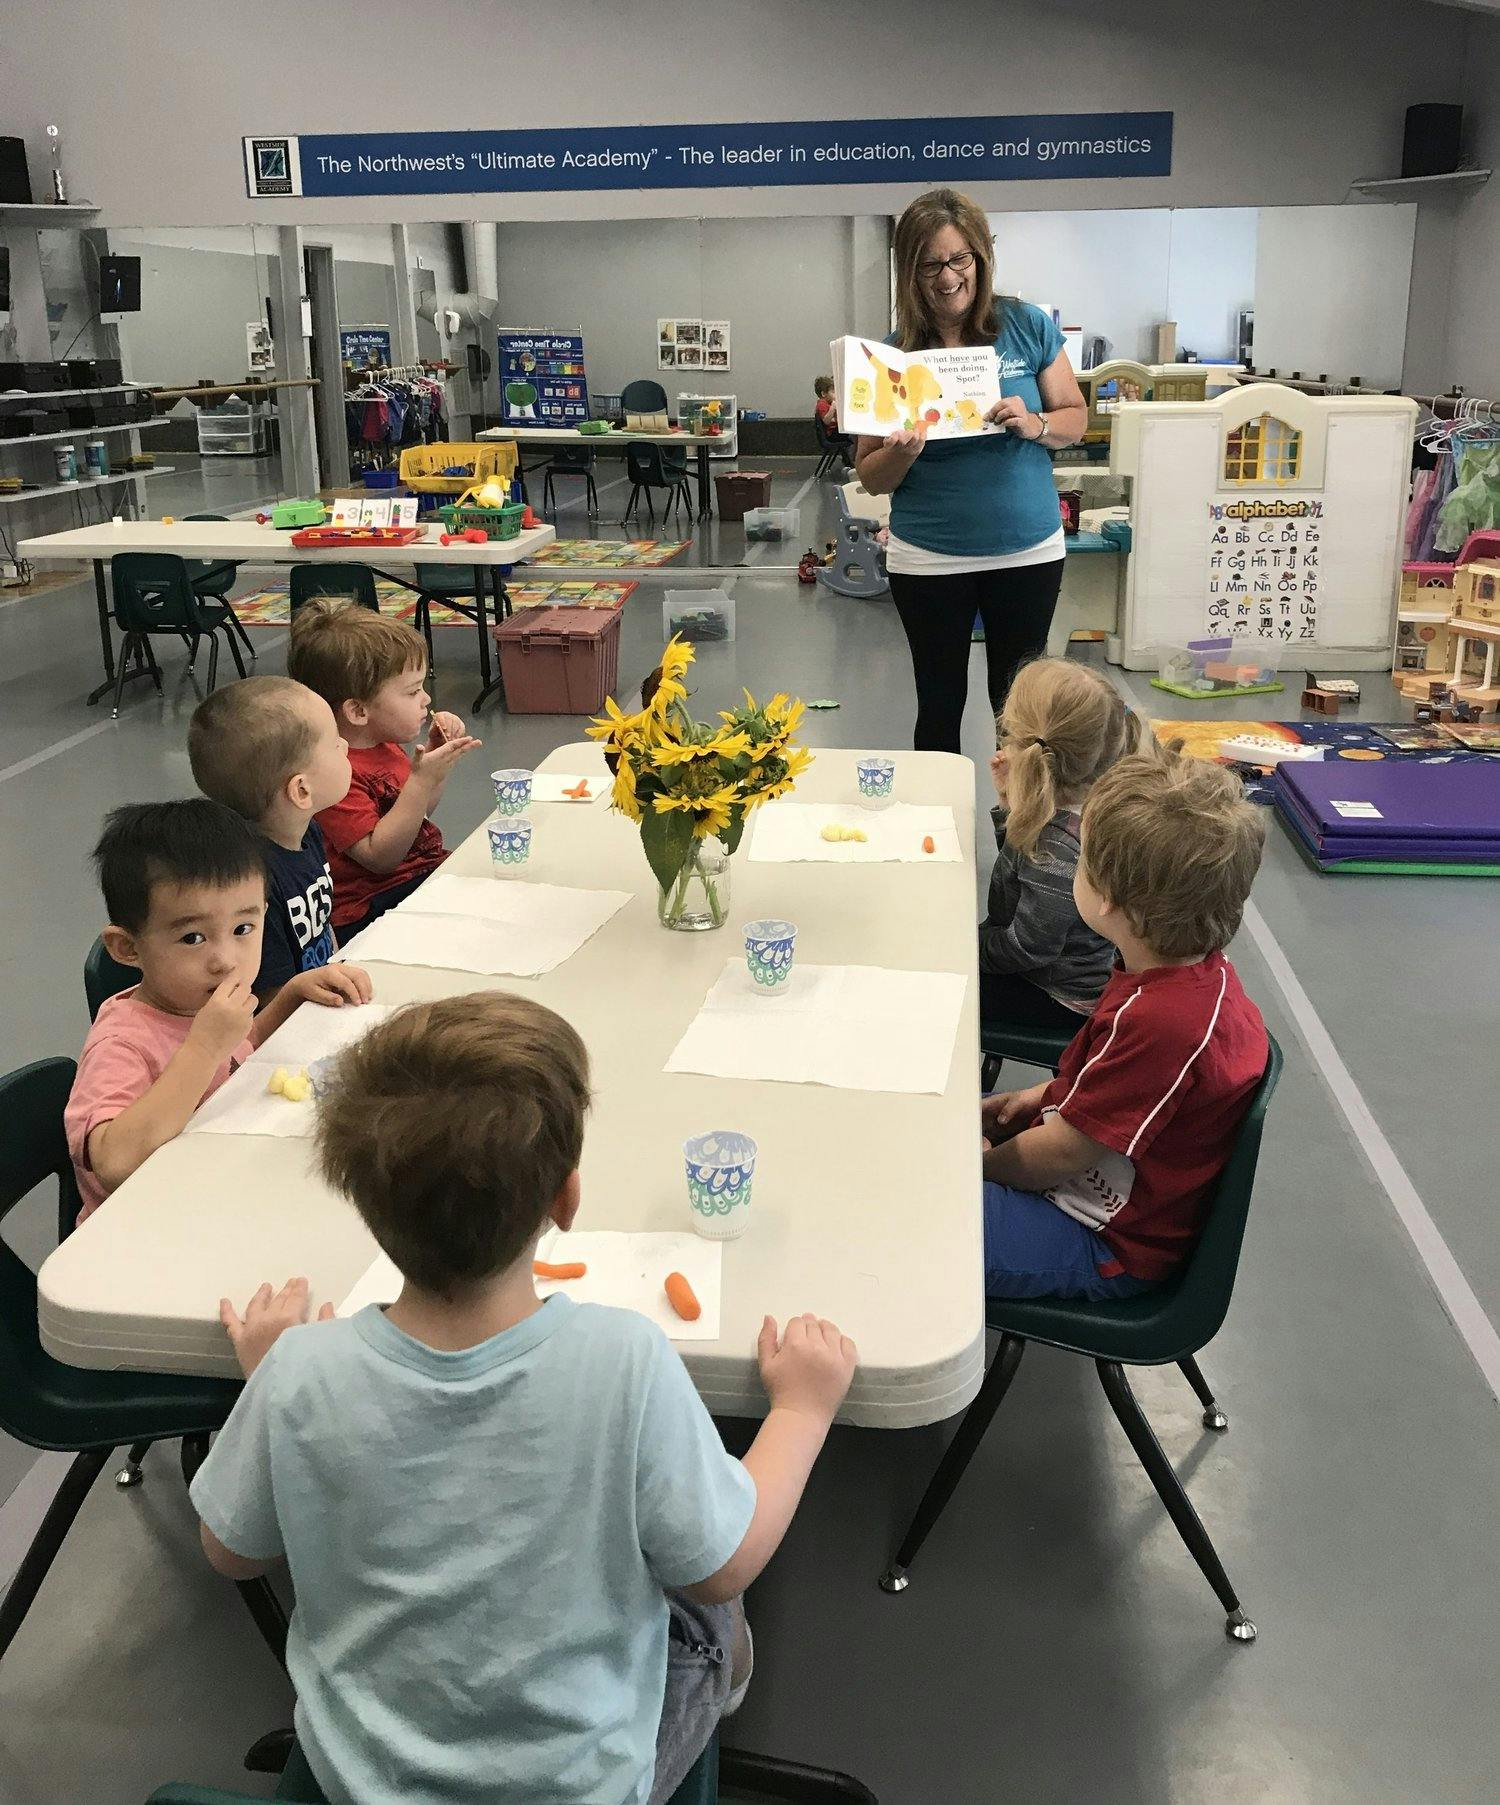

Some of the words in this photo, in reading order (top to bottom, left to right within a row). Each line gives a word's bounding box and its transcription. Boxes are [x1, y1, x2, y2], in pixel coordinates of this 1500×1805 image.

[317, 156, 351, 173] The
[358, 153, 465, 173] Northwest's
[471, 151, 556, 169] “Ultimate
[561, 148, 658, 170] Academy”
[679, 146, 714, 164] The
[721, 144, 783, 163] leader
[790, 144, 806, 162] in
[813, 142, 916, 162] education,
[923, 140, 985, 158] dance
[992, 137, 1030, 157] and
[1037, 135, 1151, 161] gymnastics
[923, 355, 948, 364] What
[949, 354, 970, 363] have
[972, 354, 989, 362] you
[938, 366, 959, 374] been
[956, 374, 980, 384] Spot?
[347, 507, 358, 519] 3
[375, 507, 386, 519] 4
[403, 506, 414, 519] 5
[1226, 500, 1306, 522] alphabet
[1211, 533, 1229, 543] Aa
[1235, 532, 1250, 543] Bb
[1258, 531, 1274, 542] Cc
[1281, 531, 1298, 541] Dd
[1305, 530, 1320, 541] Ee
[1211, 557, 1222, 567] Ff
[1227, 556, 1245, 570] Gg
[1251, 556, 1267, 567] Hh
[1273, 556, 1281, 567] Ii
[1286, 555, 1296, 569] Jj
[1303, 555, 1319, 566] Kk
[1226, 582, 1248, 592] Mm
[1253, 581, 1271, 592] Nn
[1277, 580, 1298, 591] Oo
[1302, 581, 1317, 593] Pp
[1208, 605, 1230, 618] Qq
[1237, 605, 1251, 615] Rr
[1259, 604, 1271, 615] Ss
[1279, 603, 1290, 614] Tt
[1300, 603, 1316, 614] Uu
[1258, 627, 1273, 638] Xx
[1278, 627, 1293, 641] Yy
[1300, 627, 1315, 638] Zz
